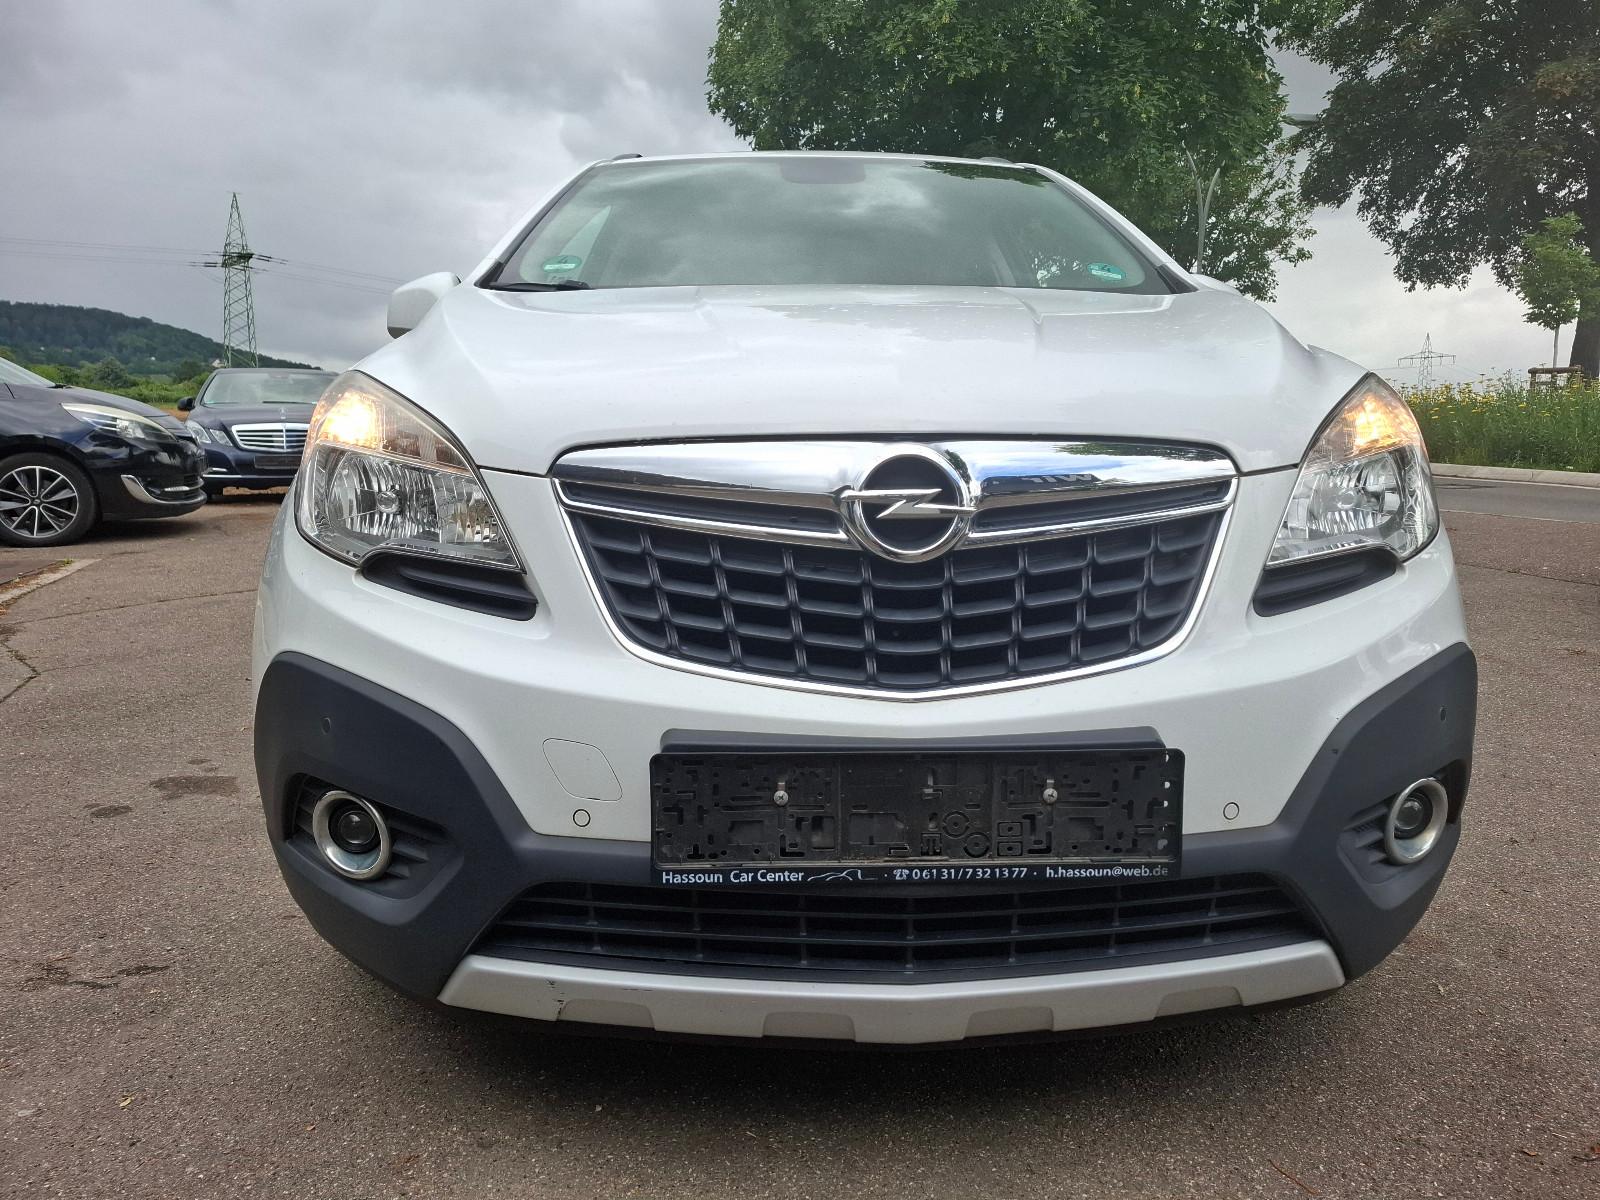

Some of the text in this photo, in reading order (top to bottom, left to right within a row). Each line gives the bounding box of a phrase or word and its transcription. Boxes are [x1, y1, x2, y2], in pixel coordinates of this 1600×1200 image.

[662, 865, 1168, 884] Hassoun Car Center 06131/7321377 h.hassoun@web.de
